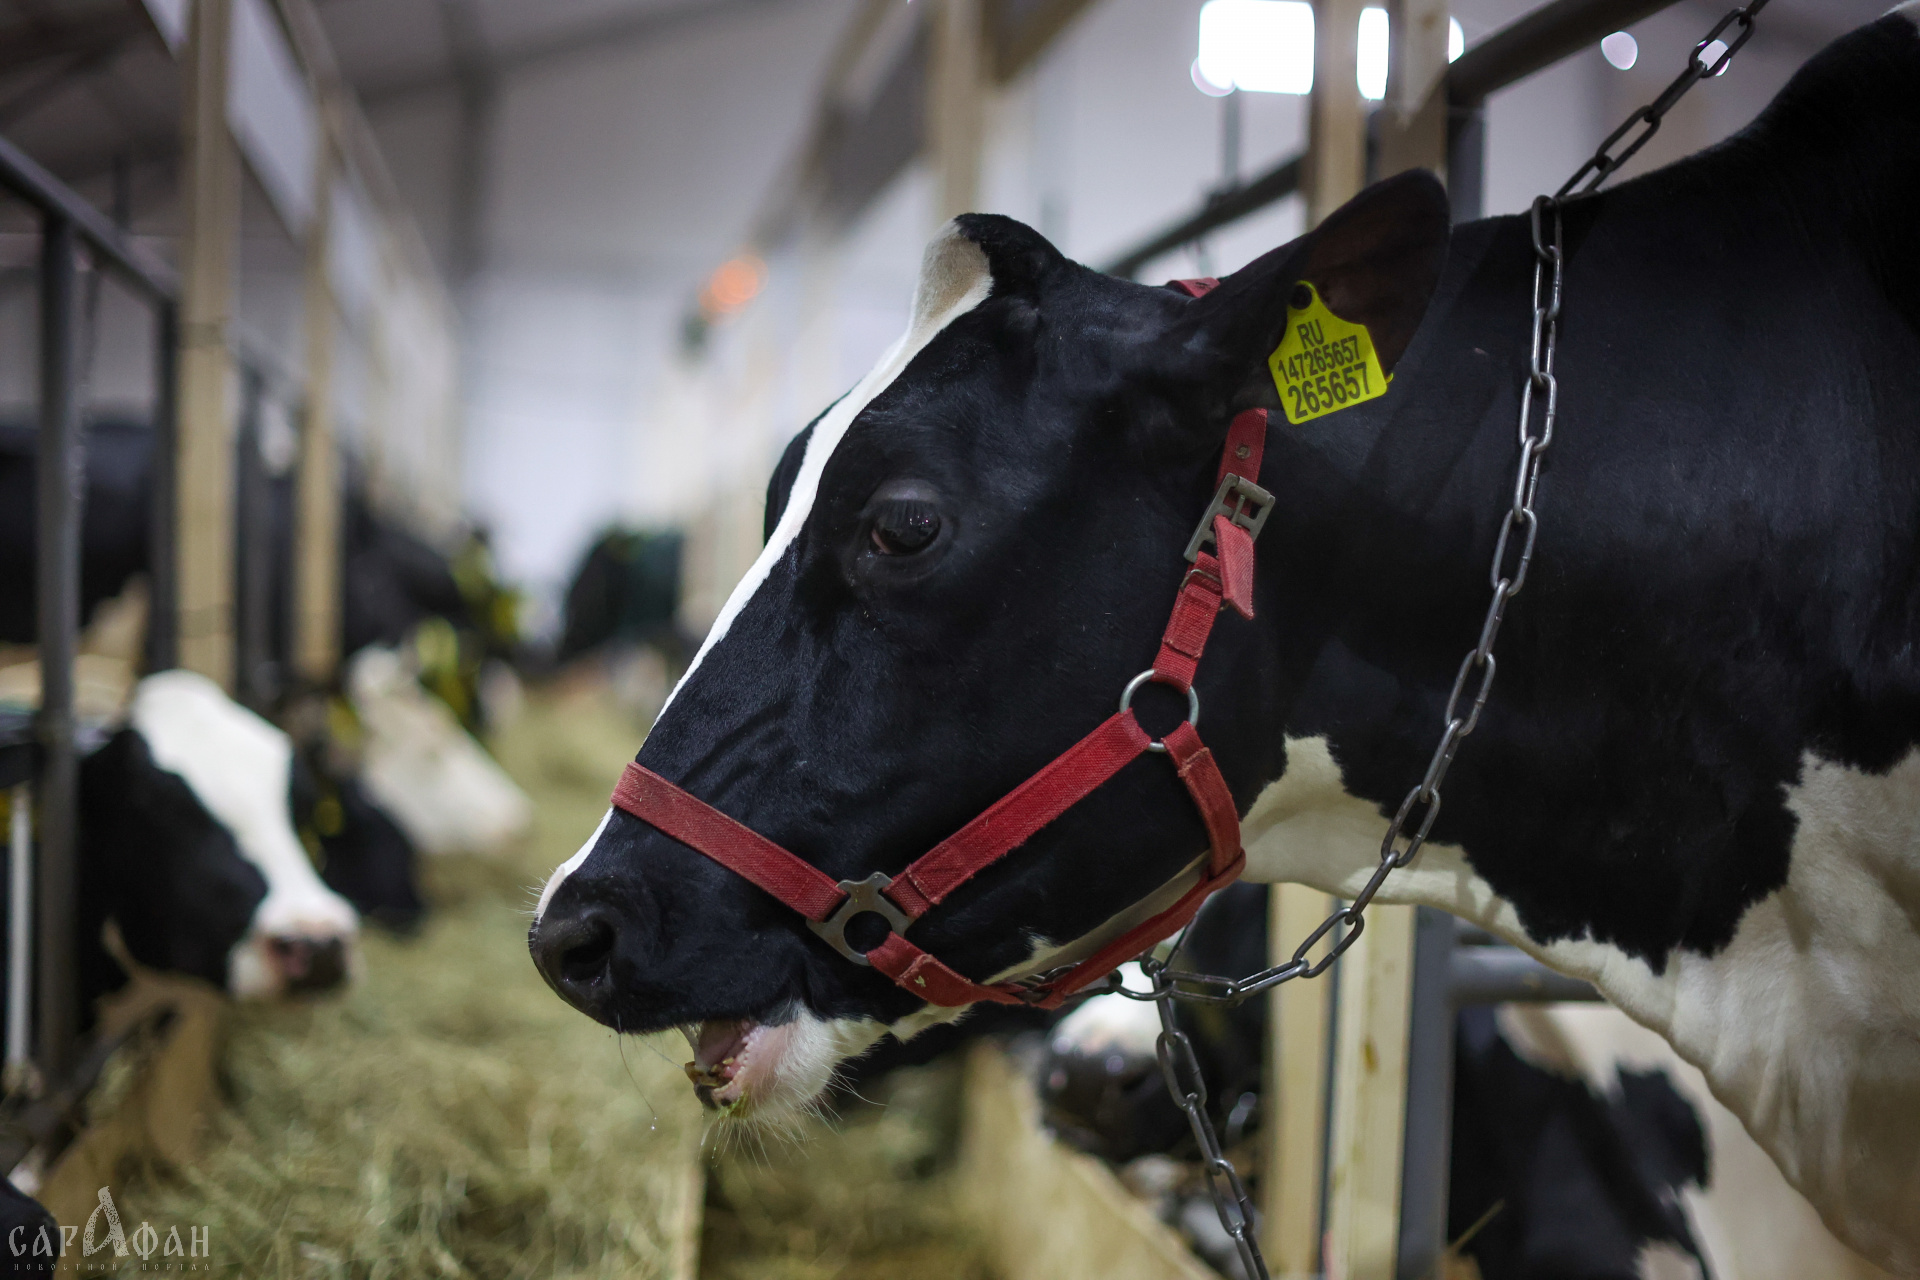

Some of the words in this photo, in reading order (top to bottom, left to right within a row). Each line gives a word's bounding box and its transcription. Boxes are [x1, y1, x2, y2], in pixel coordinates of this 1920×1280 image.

[1297, 319, 1324, 349] RU
[1278, 335, 1360, 384] 147265657
[1287, 362, 1370, 419] 265657
